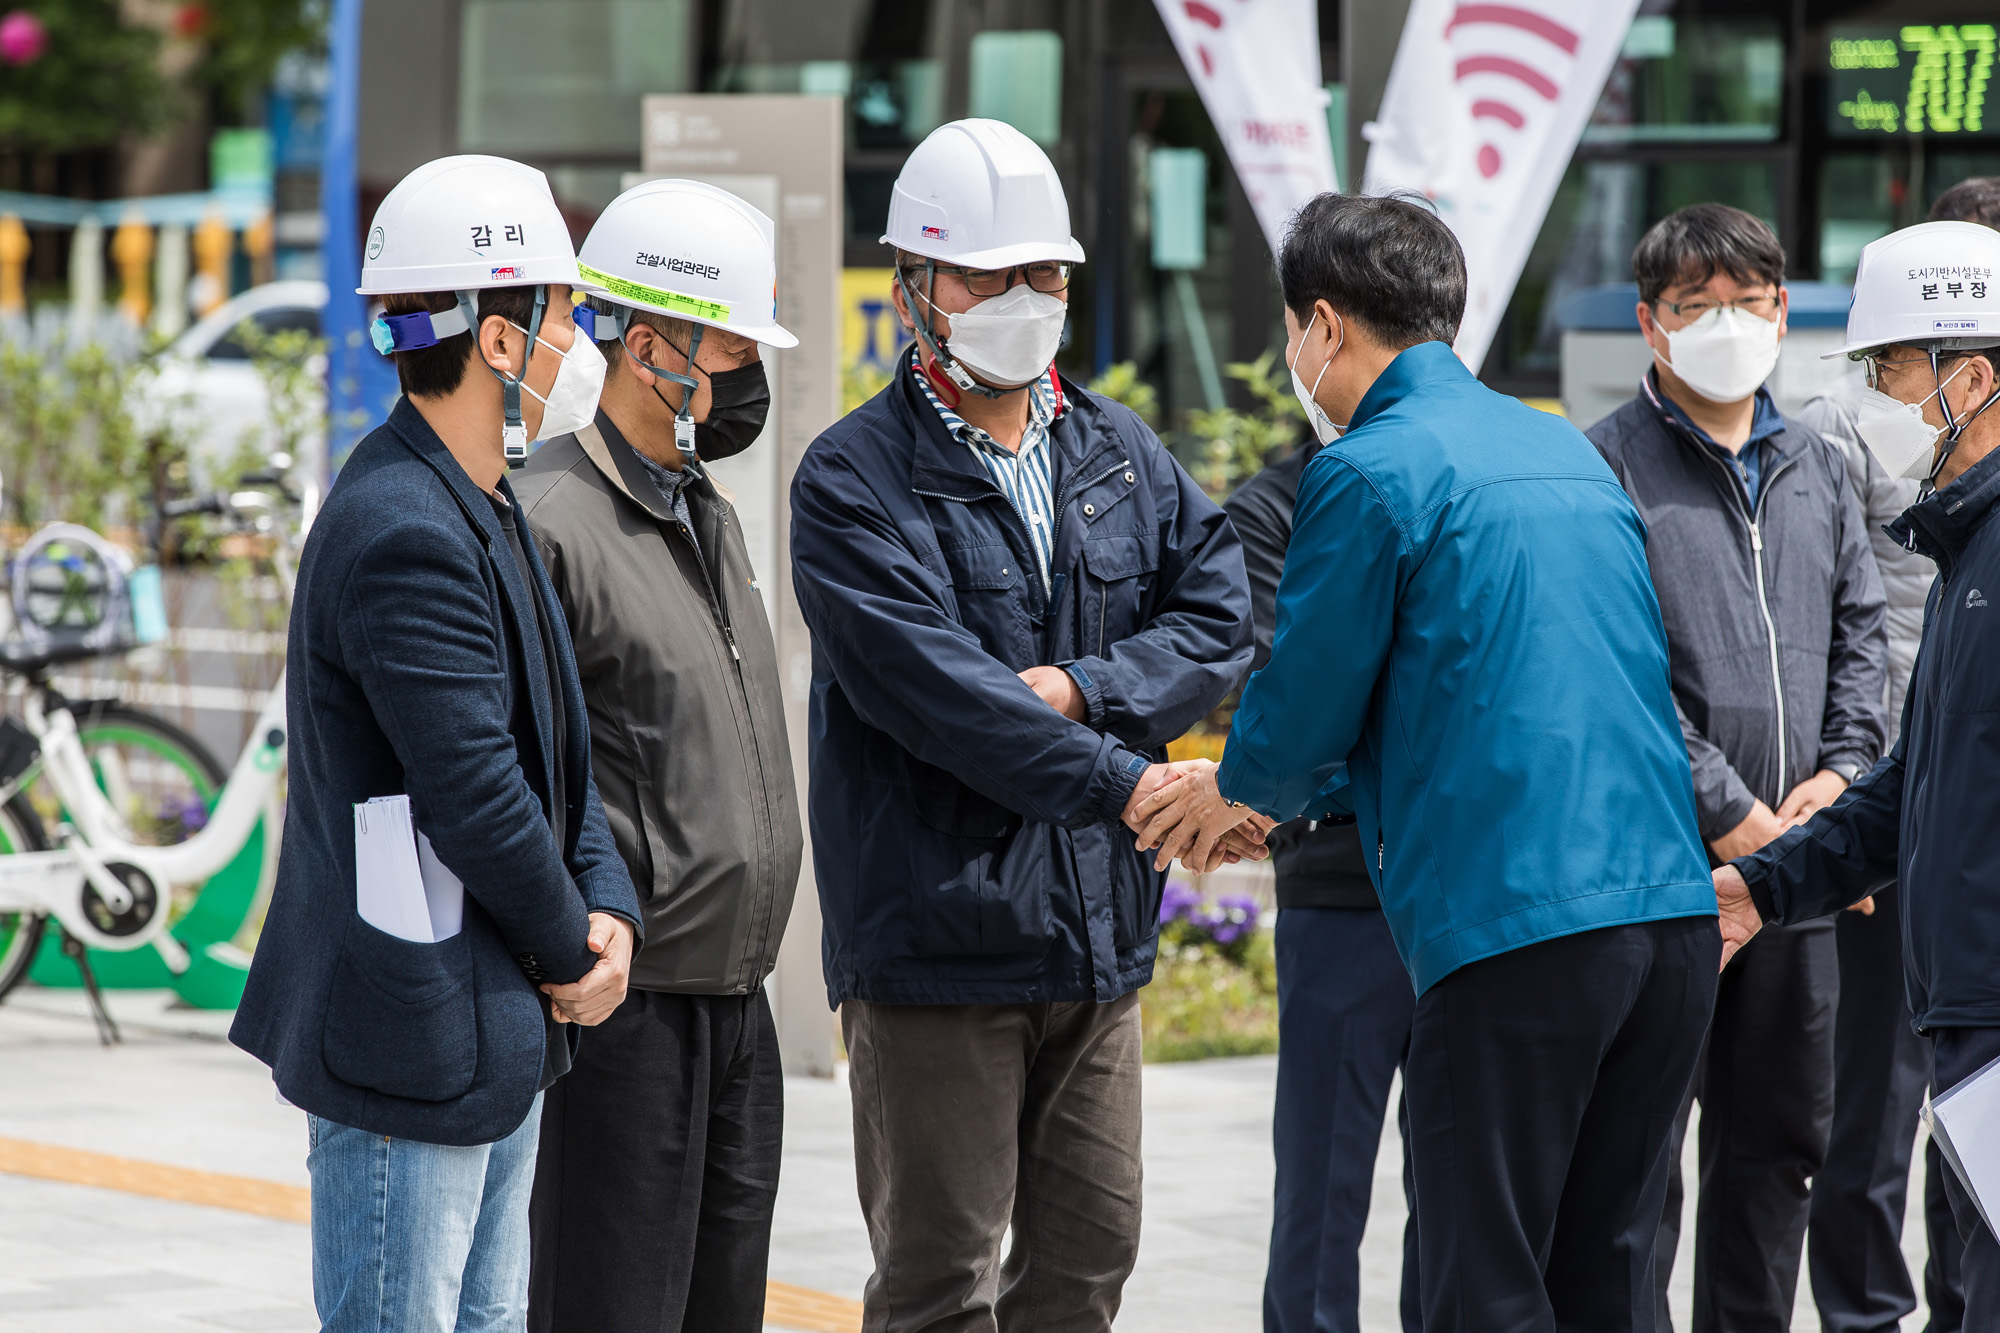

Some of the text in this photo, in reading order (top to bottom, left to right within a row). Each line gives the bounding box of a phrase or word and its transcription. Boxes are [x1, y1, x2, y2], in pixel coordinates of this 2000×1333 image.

[1899, 24, 1997, 133] 707
[635, 251, 721, 280] 건설사업관리단
[1907, 266, 1993, 280] 도시기반시설본부
